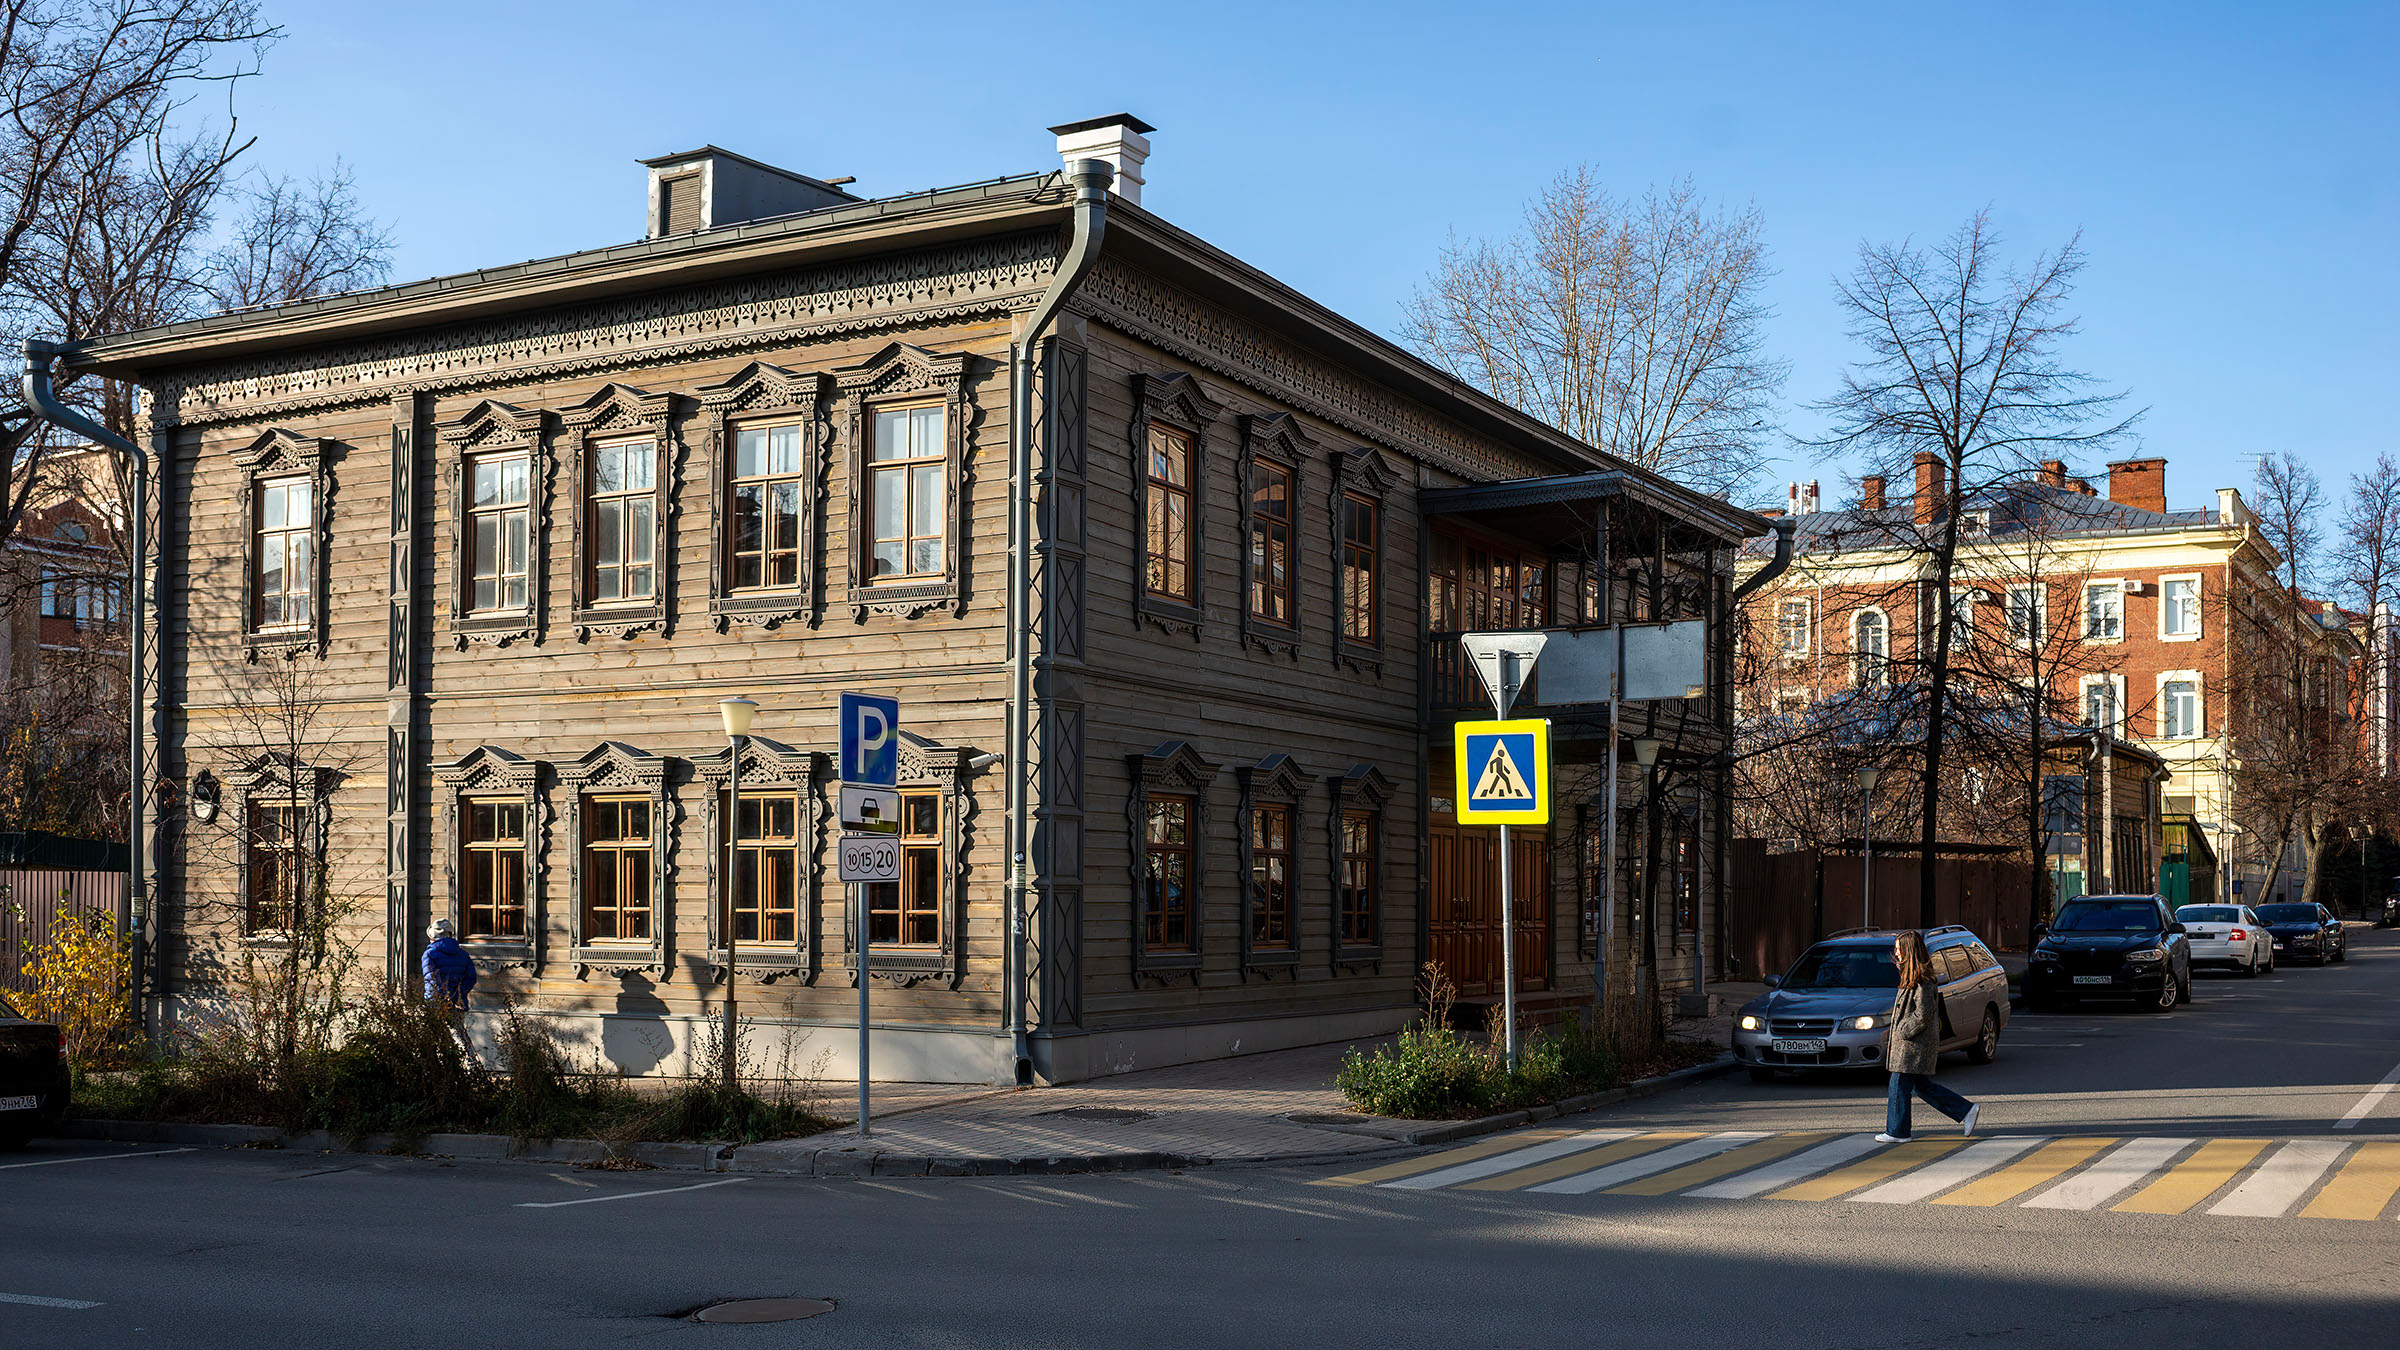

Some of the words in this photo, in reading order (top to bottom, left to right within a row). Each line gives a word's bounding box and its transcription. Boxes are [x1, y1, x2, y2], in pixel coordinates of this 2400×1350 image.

[857, 705, 888, 774] P
[848, 853, 857, 866] 10
[861, 852, 872, 867] 15
[876, 850, 894, 868] 20
